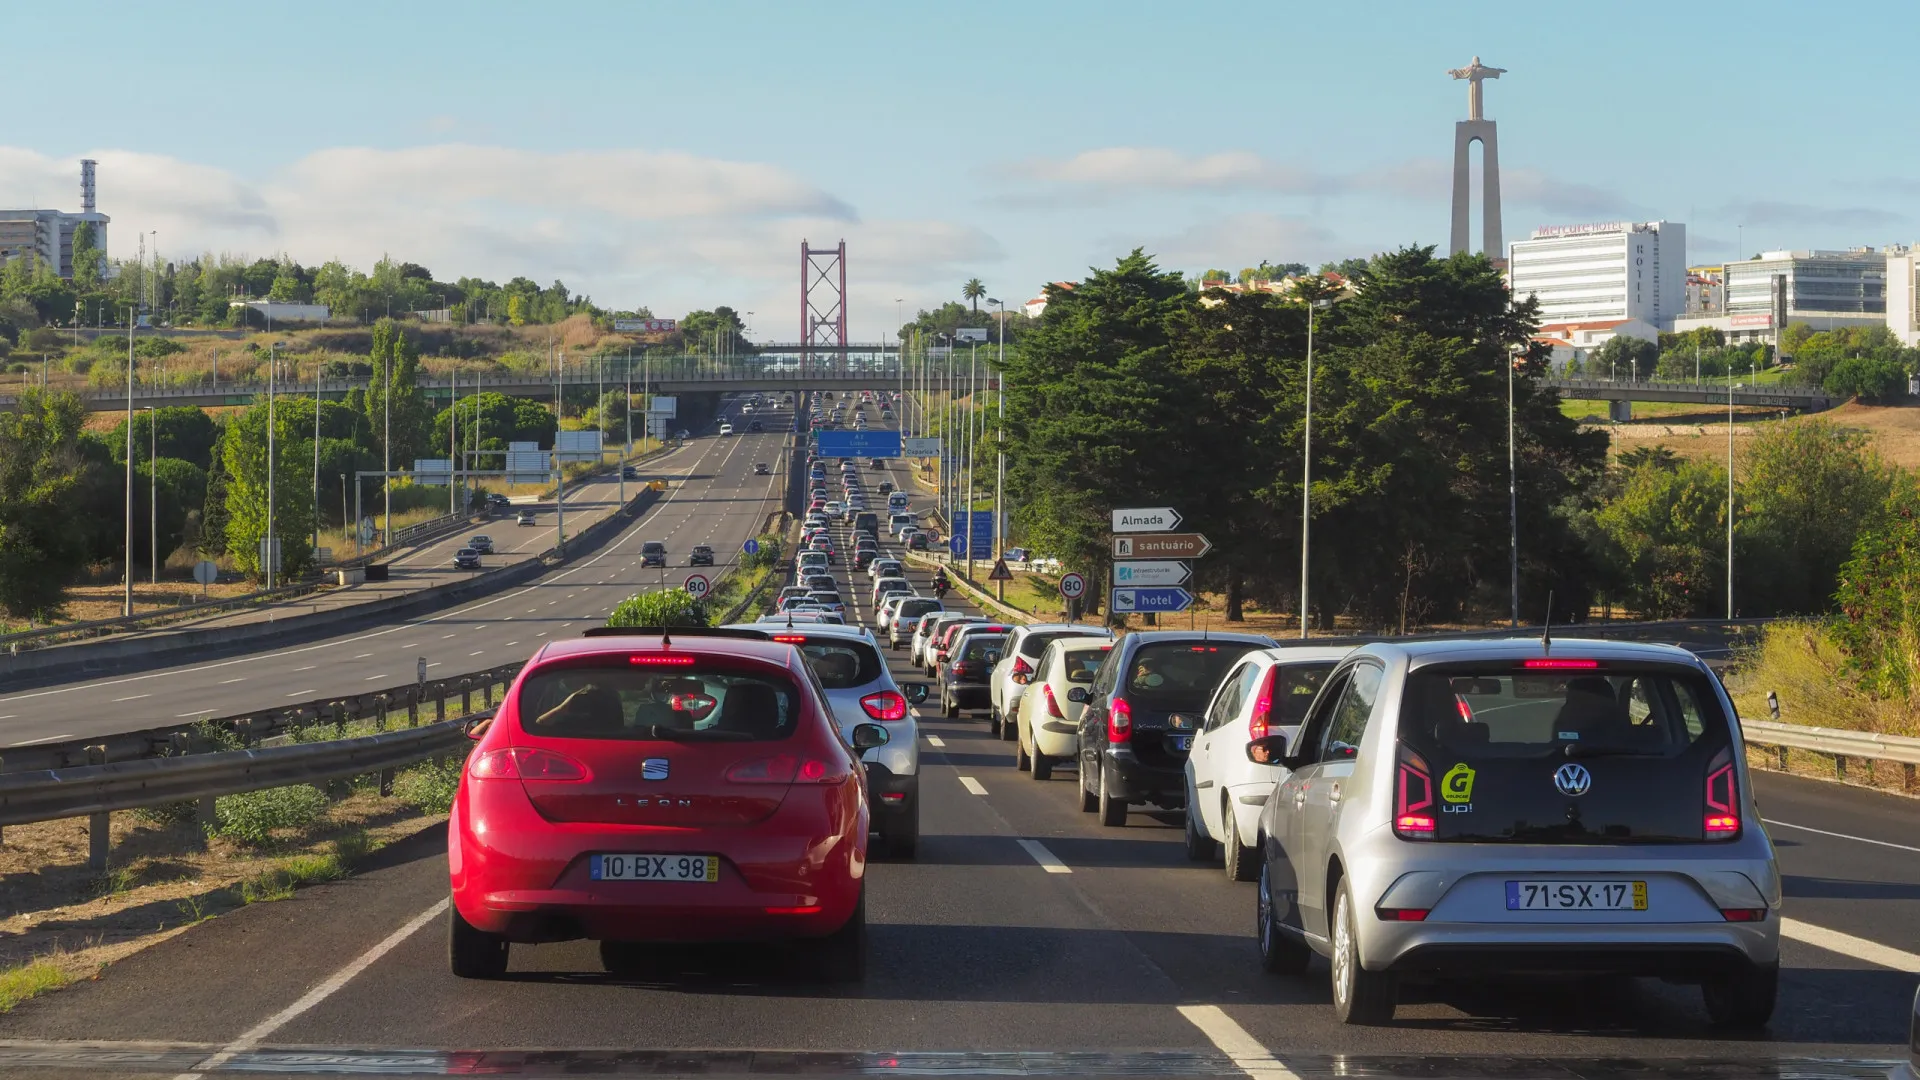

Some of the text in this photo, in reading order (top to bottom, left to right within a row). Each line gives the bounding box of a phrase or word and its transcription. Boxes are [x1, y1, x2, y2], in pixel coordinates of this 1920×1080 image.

[1539, 223, 1590, 236] Mercure
[1121, 515, 1163, 526] Almada
[1139, 540, 1194, 551] santuário
[688, 581, 706, 592] 80
[1064, 580, 1081, 592] 80
[1141, 595, 1172, 606] hotel
[617, 798, 691, 807] LEON
[1442, 803, 1473, 815] up!
